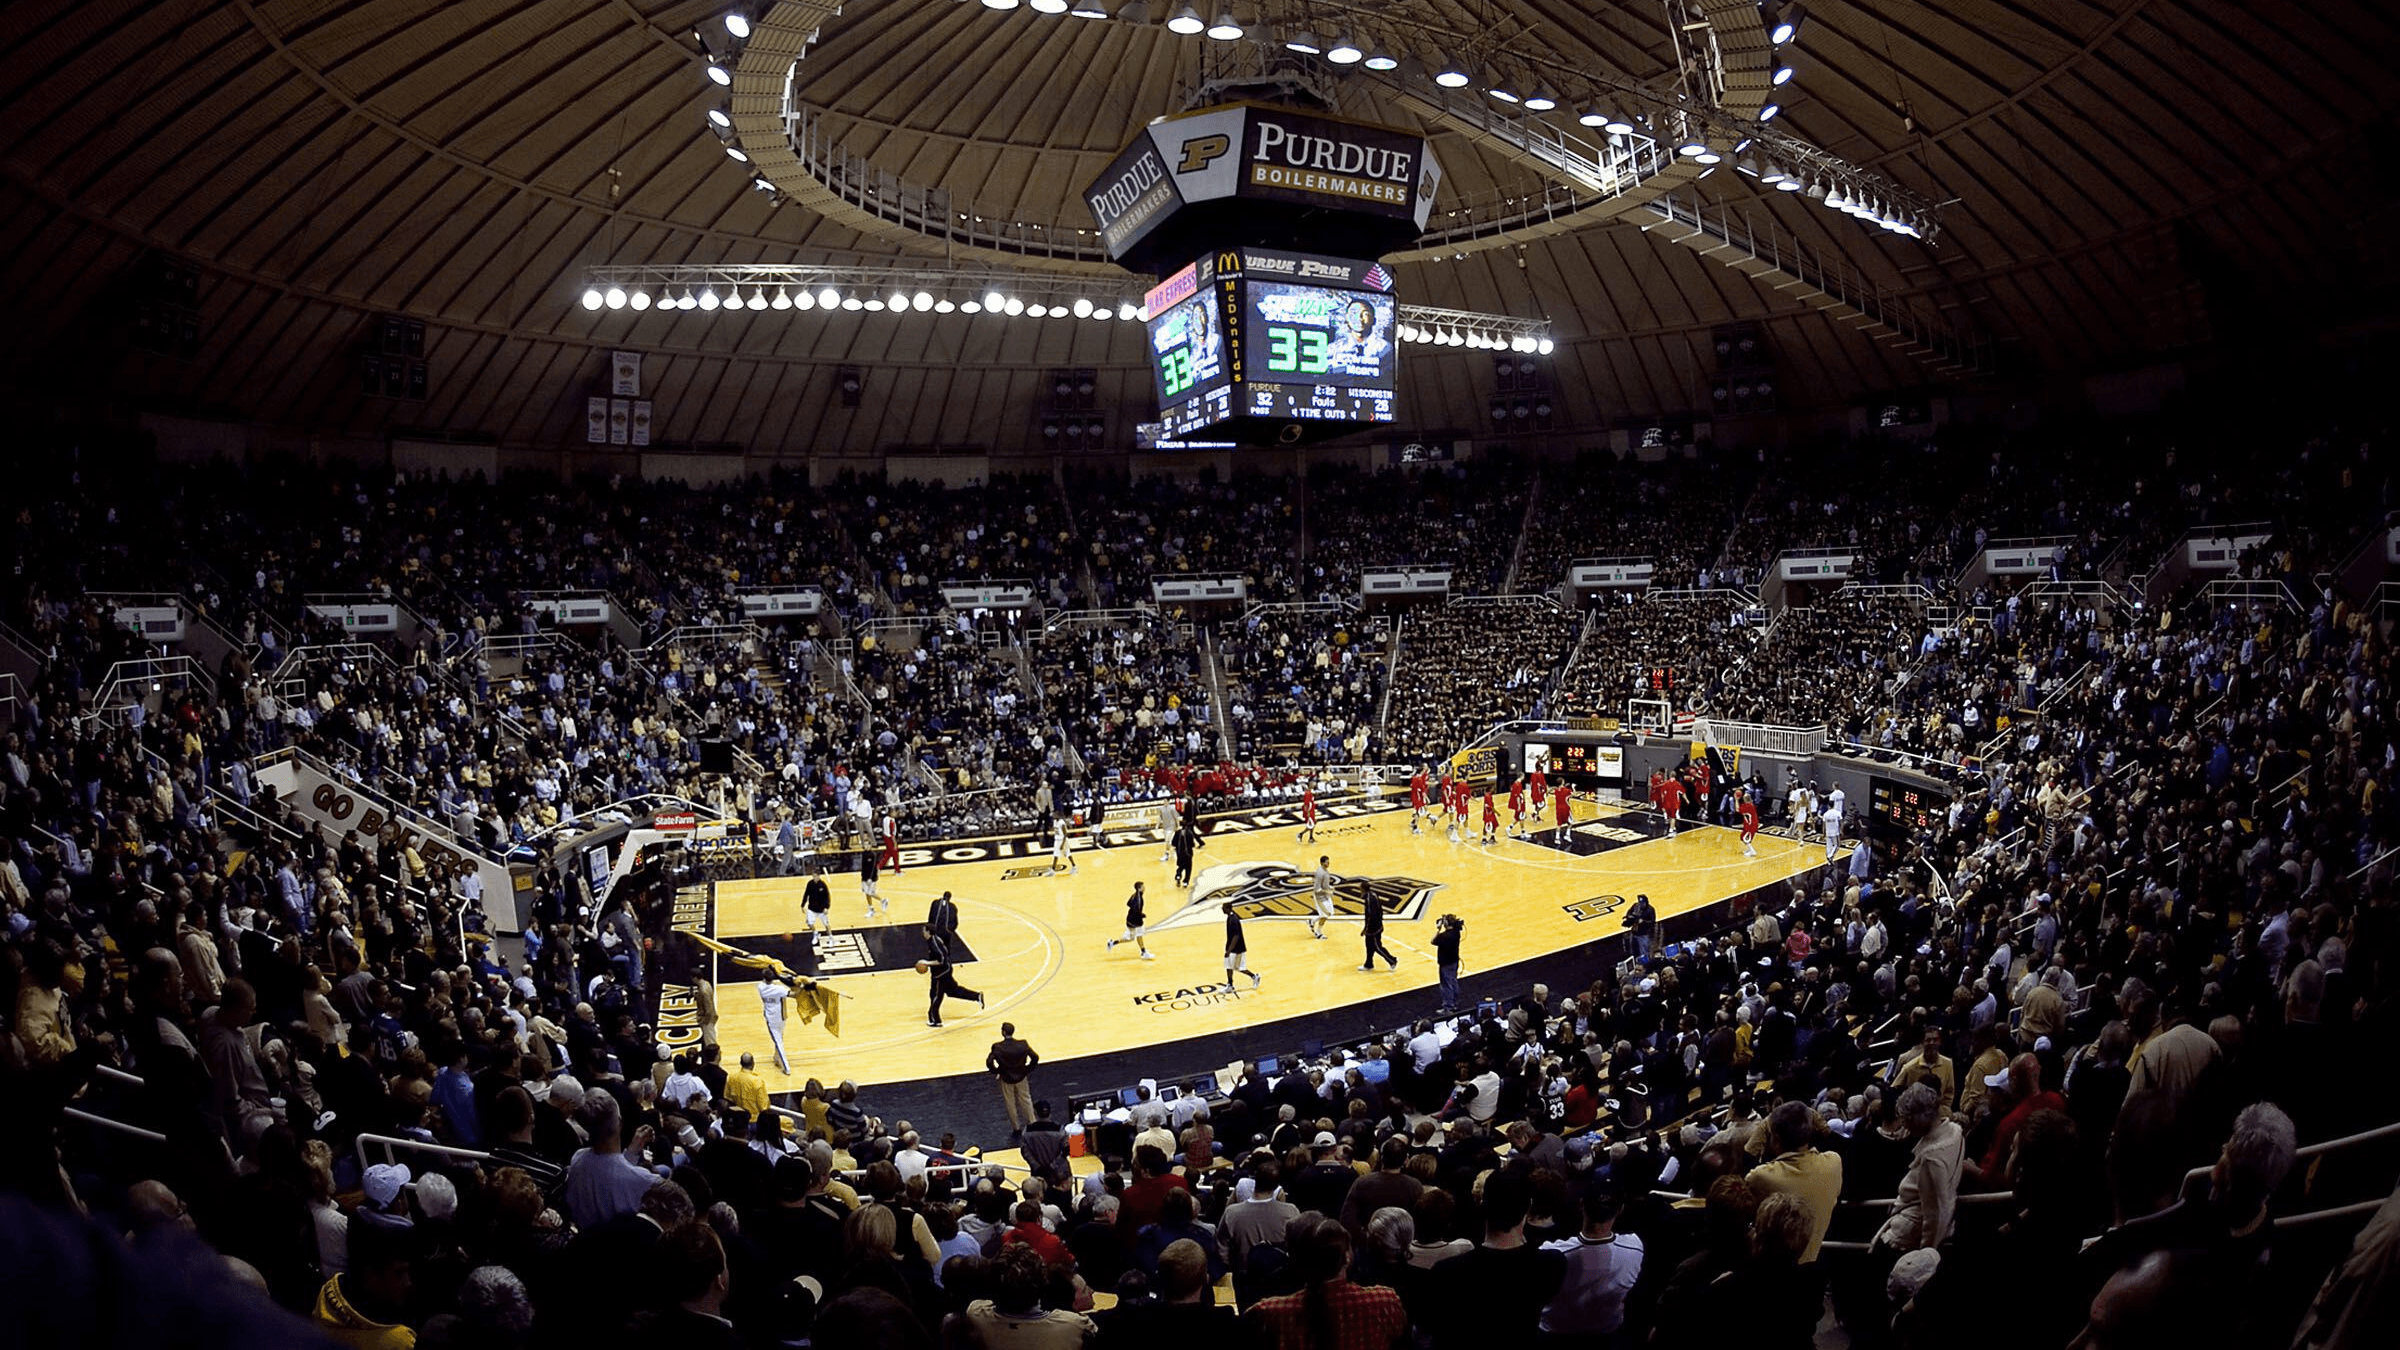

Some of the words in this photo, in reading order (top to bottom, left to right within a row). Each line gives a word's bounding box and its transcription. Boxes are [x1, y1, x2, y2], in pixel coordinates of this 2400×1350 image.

[1176, 133, 1231, 175] P
[1253, 120, 1411, 183] PURDUE
[1091, 151, 1164, 229] PURDUE
[1256, 167, 1407, 203] BOILERMAKERS
[1108, 183, 1172, 246] BOILERMAKERS
[1245, 255, 1296, 274] URDUE
[1298, 260, 1352, 280] PRIDE
[1268, 327, 1329, 374] 33
[1161, 347, 1194, 397] 33
[1248, 382, 1281, 393] PURDUE
[1348, 388, 1393, 400] WISCONSIN
[1299, 408, 1321, 418] TIME
[1324, 409, 1346, 420] OUTS
[1312, 396, 1336, 408] Fouls
[1476, 750, 1497, 762] CBS
[1552, 760, 1563, 771] 32
[1585, 762, 1596, 771] 26
[1719, 748, 1737, 761] BS
[1456, 760, 1496, 780] SPORTS
[313, 784, 354, 820] GO
[671, 884, 708, 933] ARENA
[1562, 895, 1625, 922] P
[1549, 1102, 1565, 1119] 33
